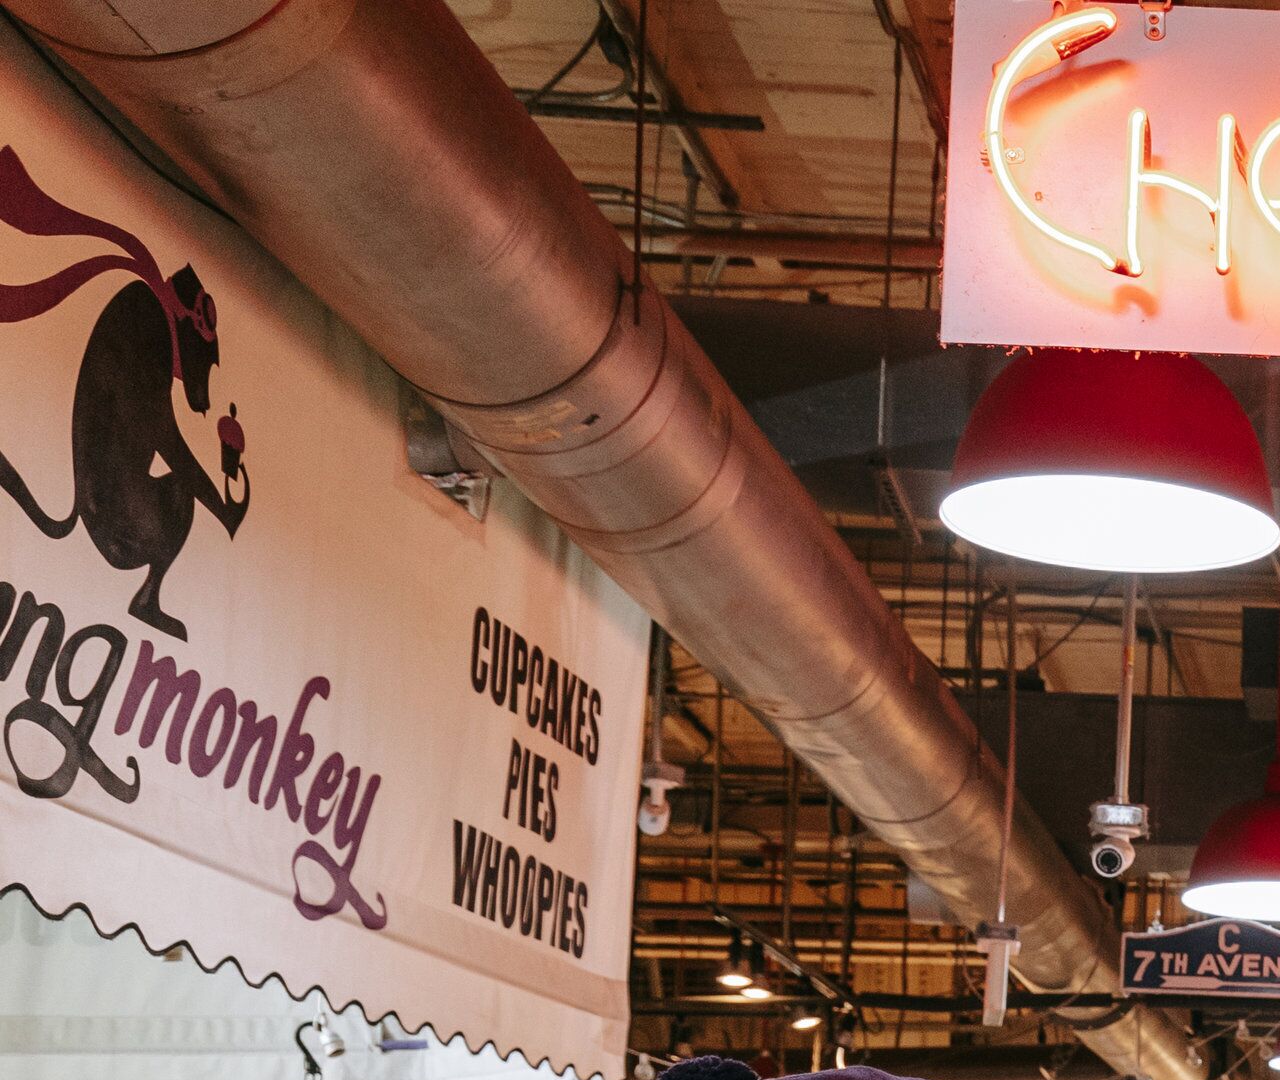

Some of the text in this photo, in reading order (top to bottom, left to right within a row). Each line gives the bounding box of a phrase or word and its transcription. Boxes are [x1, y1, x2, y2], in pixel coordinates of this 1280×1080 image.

[470, 606, 602, 766] CUPCAKES
[115, 640, 387, 930] monkey
[502, 736, 560, 843] PIES
[452, 818, 588, 958] WHOOPIES
[1217, 923, 1241, 954] C
